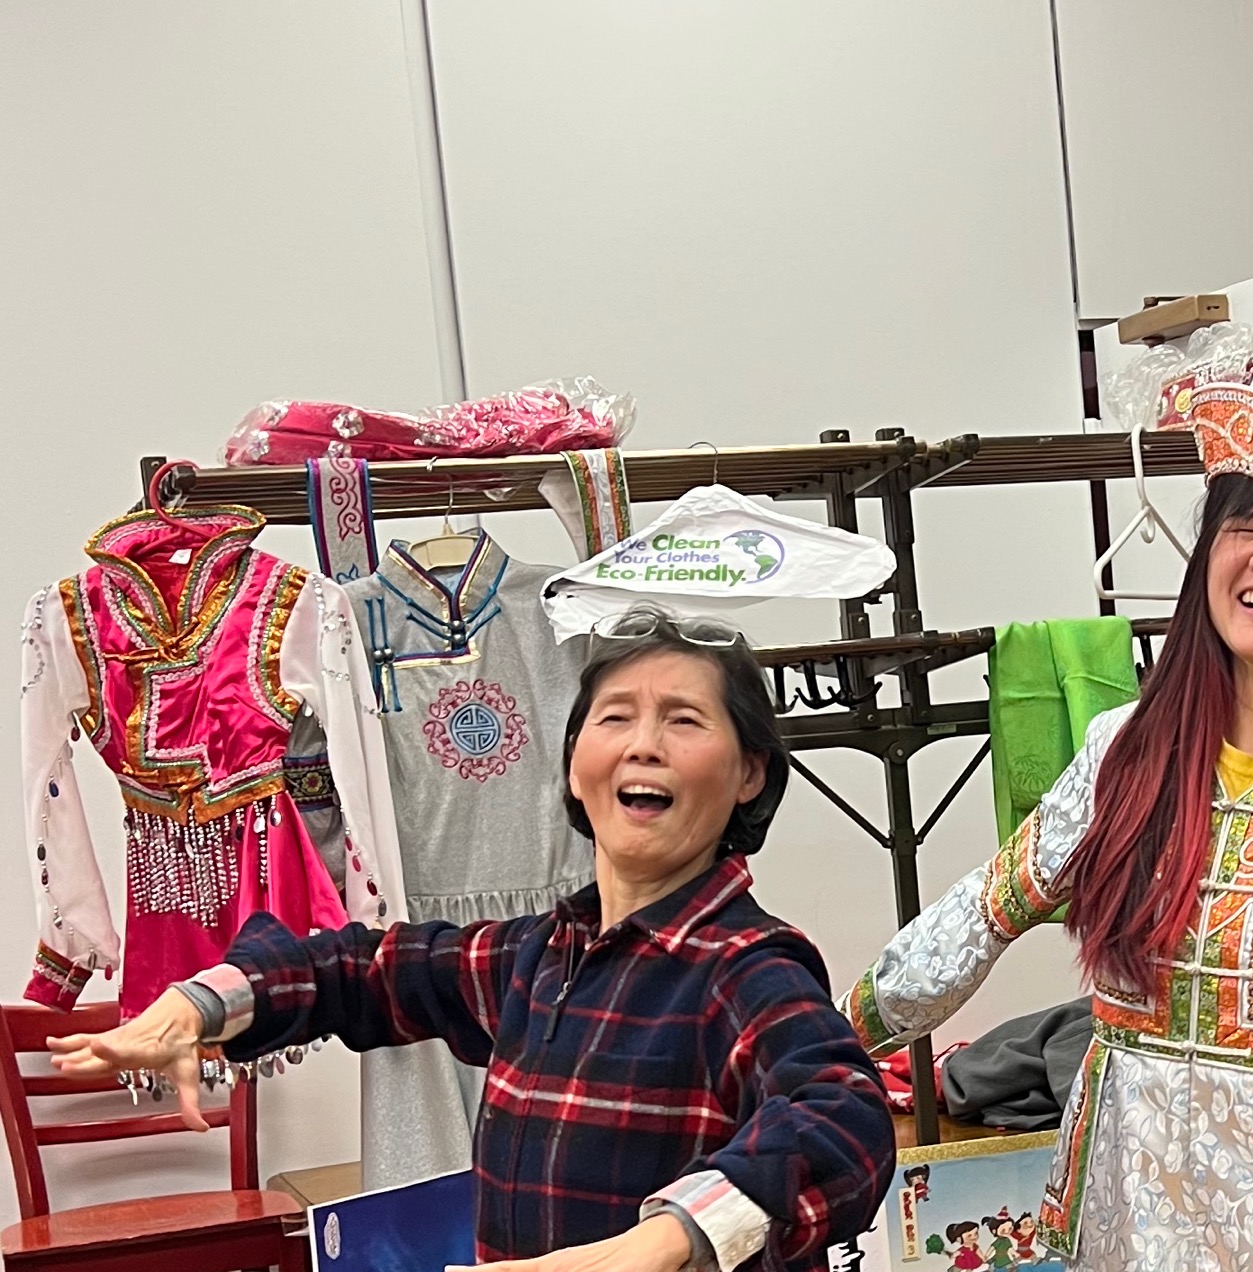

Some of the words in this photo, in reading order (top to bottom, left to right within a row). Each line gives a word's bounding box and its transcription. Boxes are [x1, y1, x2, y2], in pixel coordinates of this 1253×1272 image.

[620, 538, 647, 551] We
[652, 534, 720, 551] Clean
[614, 550, 652, 564] Your
[656, 551, 720, 563] Clothes
[596, 562, 747, 587] Eco-Friendly.
